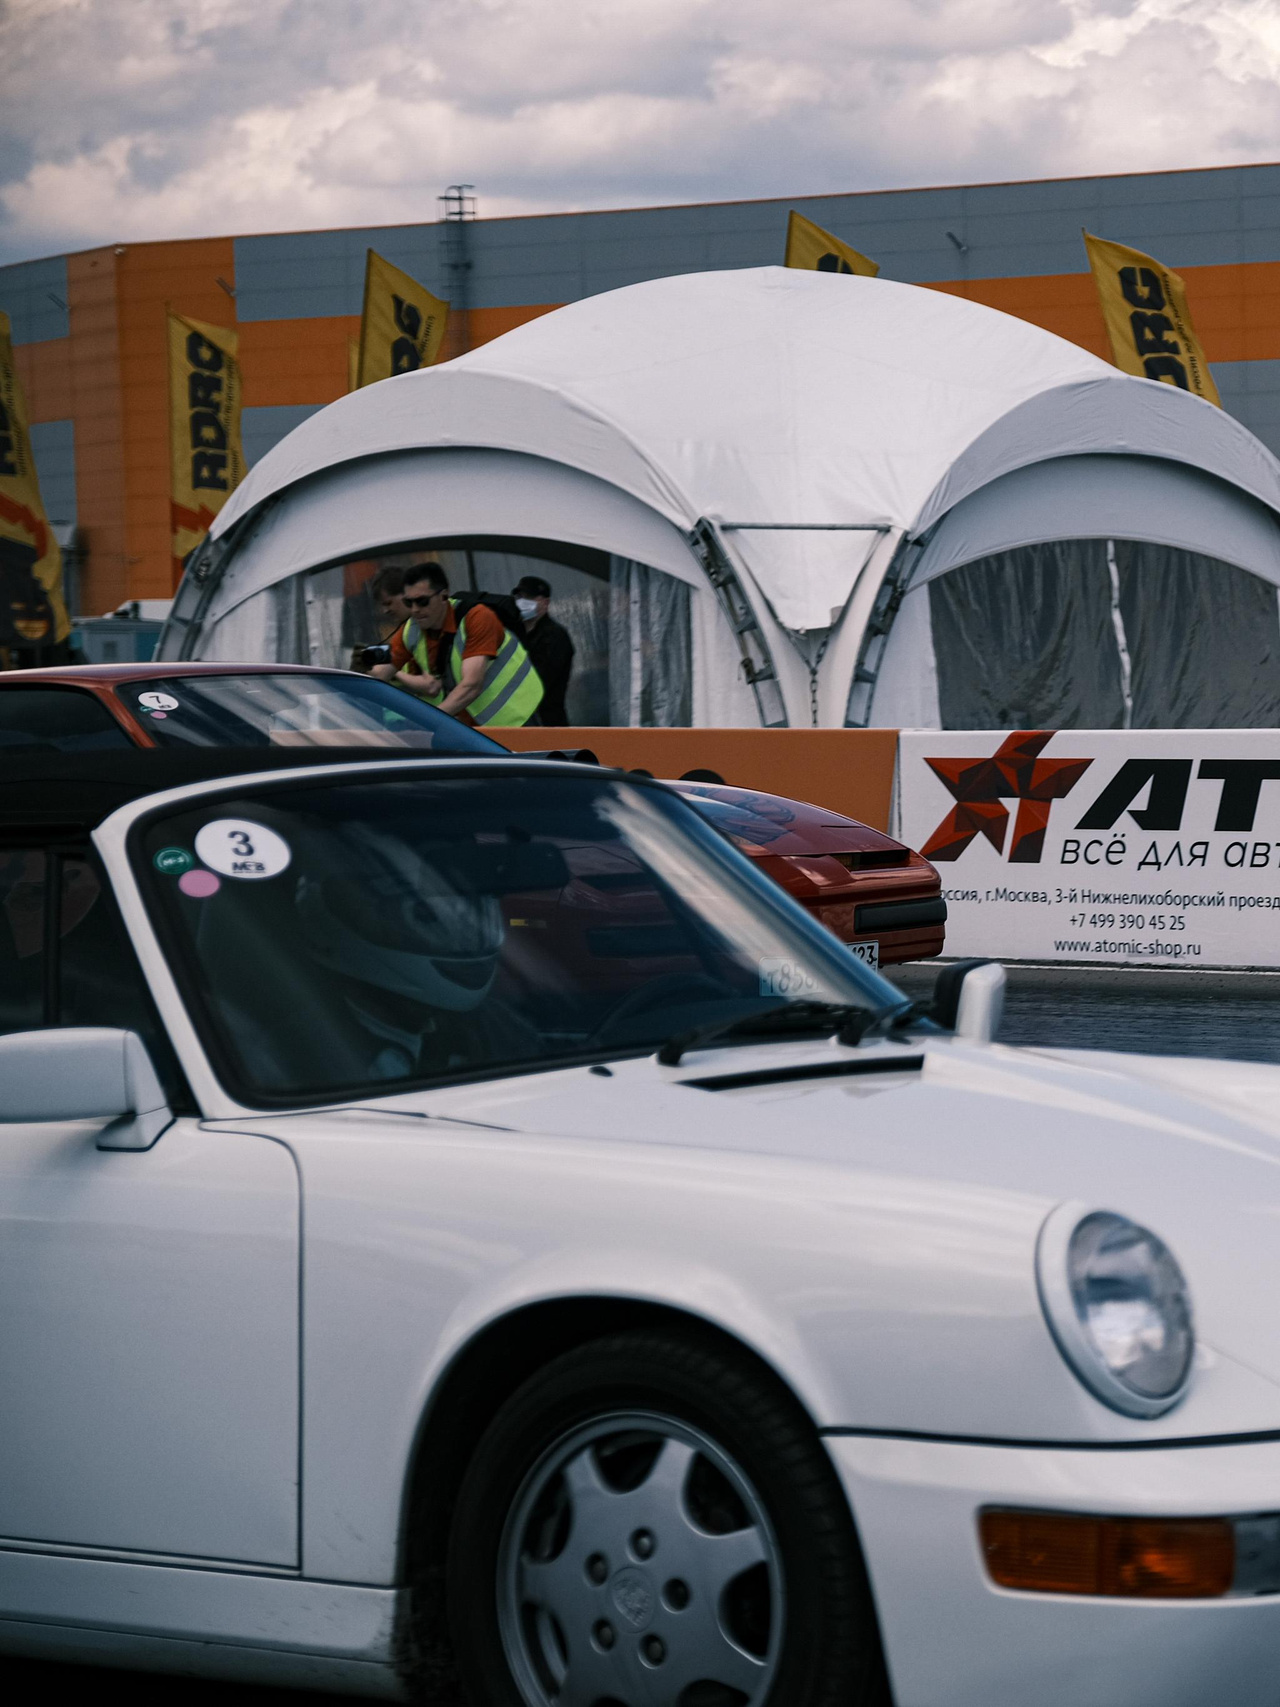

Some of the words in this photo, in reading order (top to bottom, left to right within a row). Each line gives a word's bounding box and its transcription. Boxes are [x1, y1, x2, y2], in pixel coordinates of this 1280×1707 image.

[148, 695, 161, 705] 7
[226, 830, 255, 857] 3
[1137, 841, 1210, 871] для
[940, 889, 982, 904] оссия,
[986, 887, 1051, 905] г.Москва,
[1055, 888, 1078, 904] 3-й
[1081, 889, 1226, 909] Нижнелихоборский
[1069, 913, 1086, 928] +7
[1089, 913, 1115, 929] 499
[1119, 914, 1146, 930] 390
[1148, 914, 1166, 930] 45
[1169, 915, 1186, 931] 25
[1053, 938, 1202, 958] www.atomic-shop.ru
